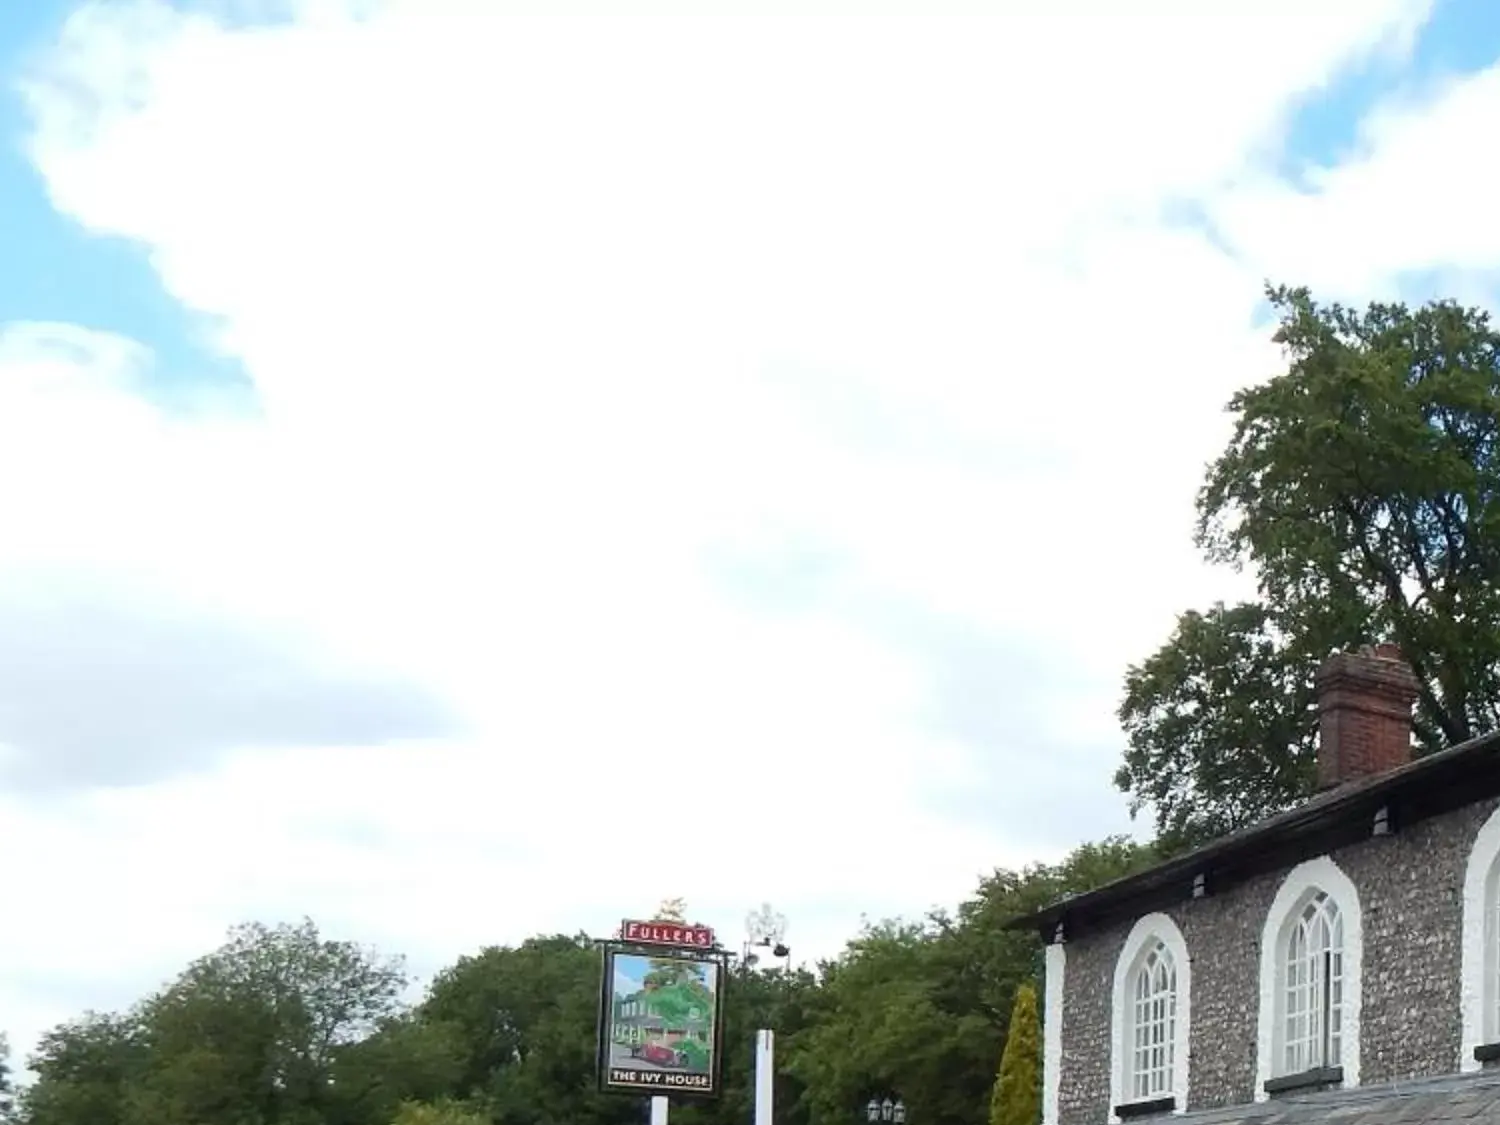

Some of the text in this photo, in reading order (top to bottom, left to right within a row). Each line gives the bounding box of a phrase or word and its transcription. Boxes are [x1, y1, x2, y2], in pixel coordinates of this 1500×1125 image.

[613, 1070, 709, 1087] THE IVY HOUSE
